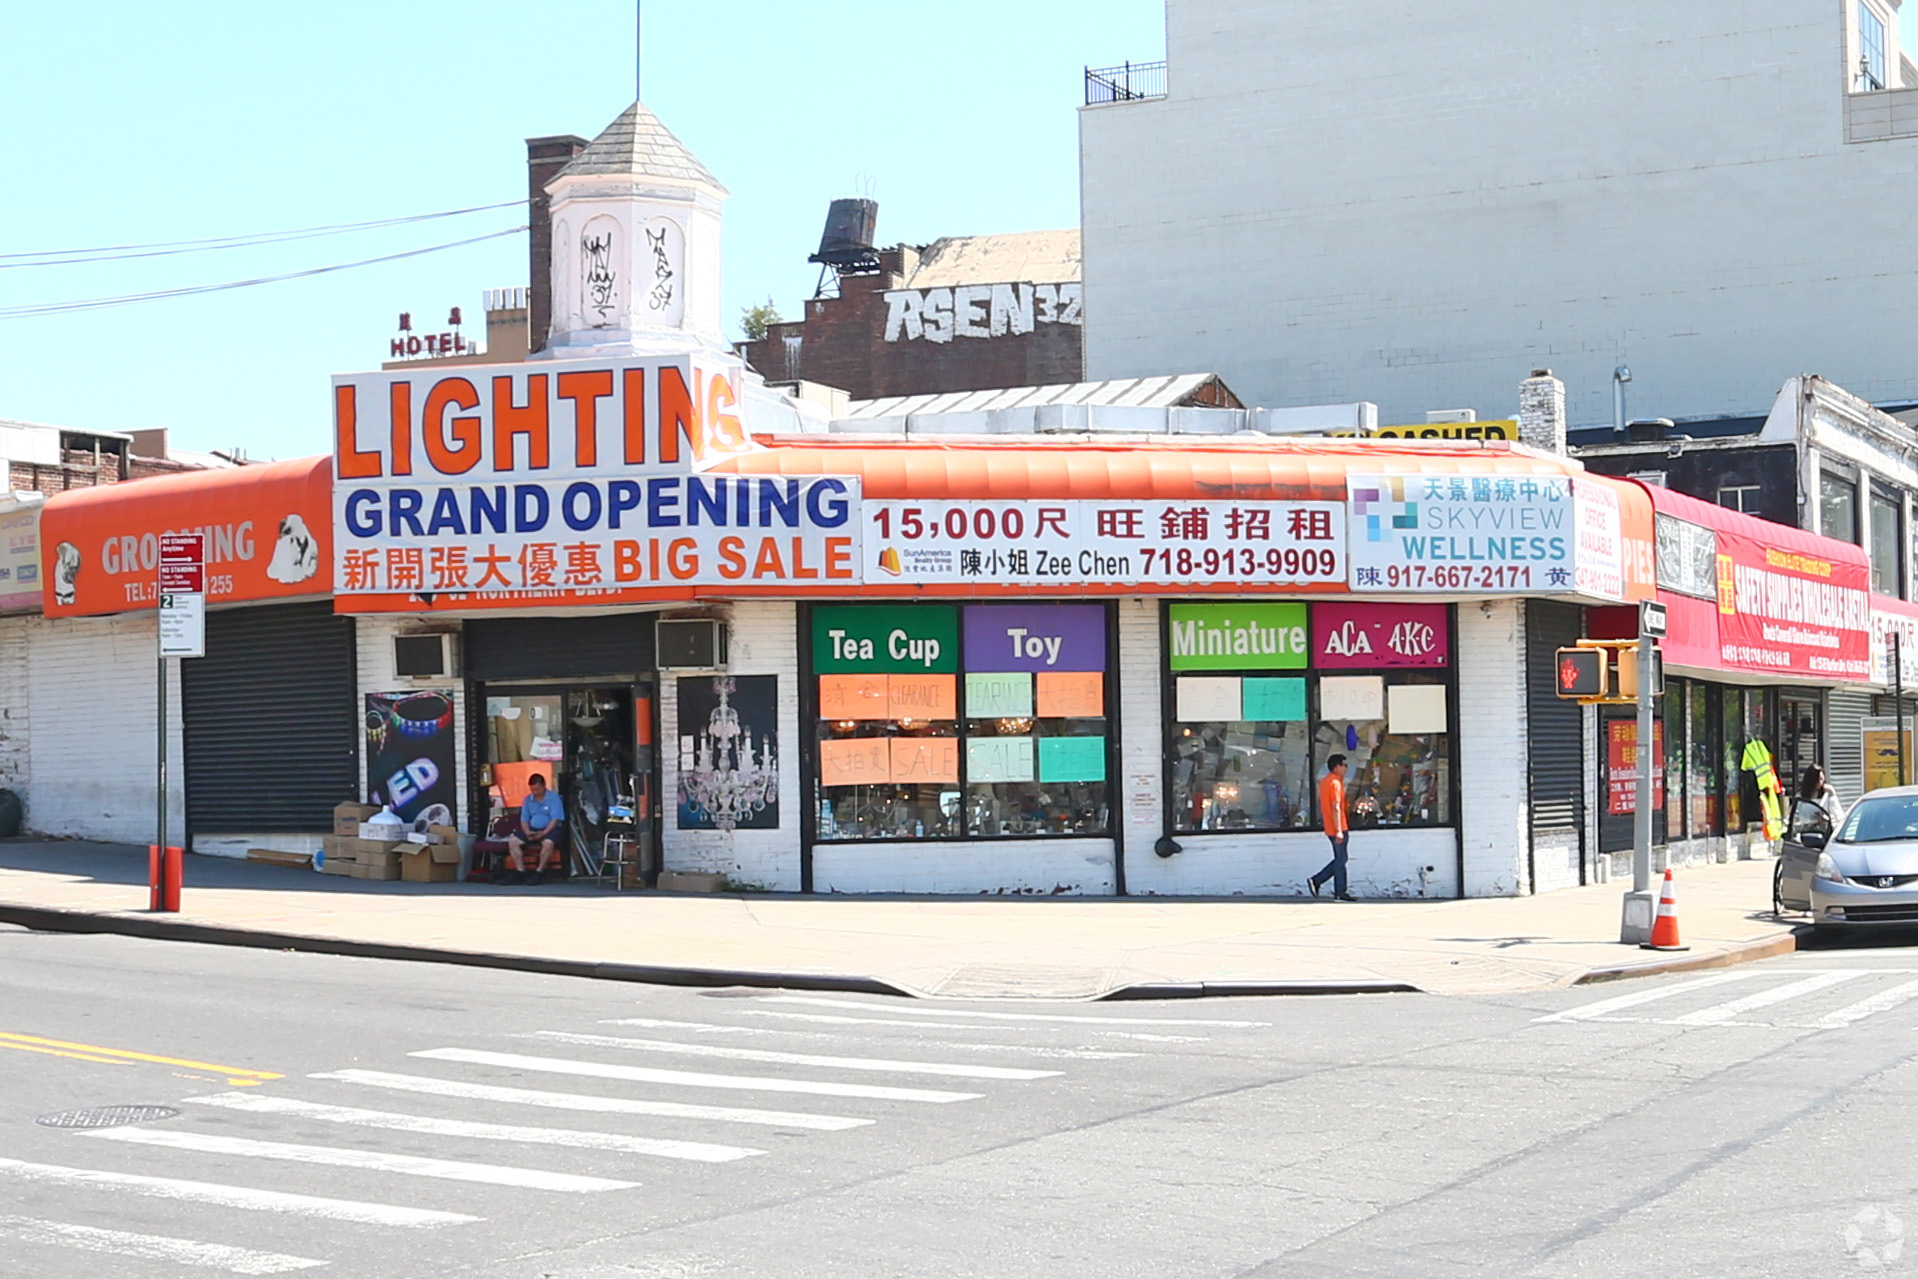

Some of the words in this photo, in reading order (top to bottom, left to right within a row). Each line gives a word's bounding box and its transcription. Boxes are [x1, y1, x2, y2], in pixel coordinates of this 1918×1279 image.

[390, 332, 466, 357] HOTEL
[334, 365, 750, 480] LIGHTING
[345, 484, 550, 538] GRAND
[561, 477, 849, 531] OPENING
[1427, 506, 1563, 530] SKYVIEW
[343, 541, 602, 591] 新開張大優惠
[613, 537, 699, 583] BIG
[717, 536, 853, 580] SALE
[960, 548, 1030, 577] 陳小姐
[1036, 550, 1072, 576] Zee
[1078, 550, 1130, 576] Chen
[1139, 547, 1336, 576] 718-913-9909
[1402, 536, 1566, 561] WELLNESS
[1387, 565, 1531, 588] 917-667-2171
[162, 595, 171, 608] 2
[828, 629, 873, 660] Tea
[888, 629, 940, 667] Cup
[1007, 628, 1062, 665] Toy
[1172, 619, 1306, 657] Miniature
[1324, 620, 1373, 657] ACA
[890, 684, 940, 708] CLEARANCE
[896, 746, 954, 776] SALE
[968, 742, 1032, 780] SALE
